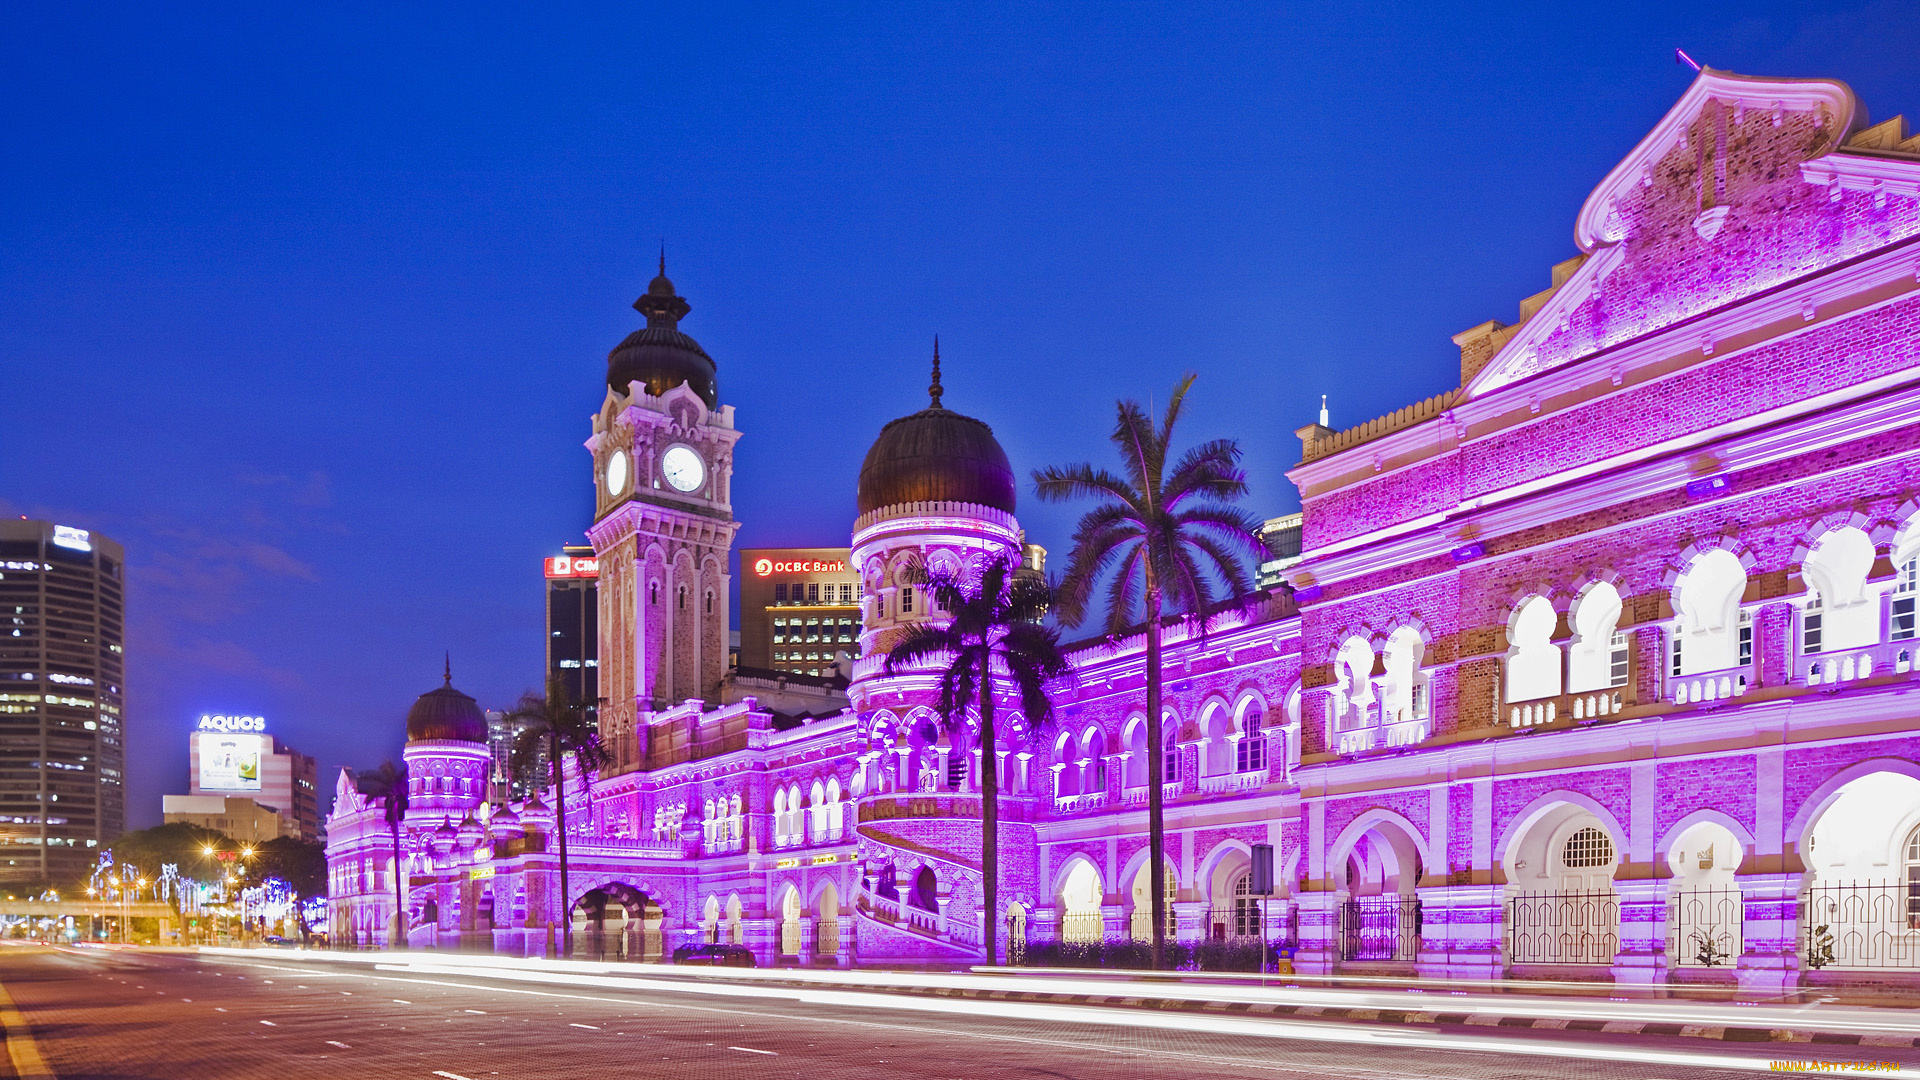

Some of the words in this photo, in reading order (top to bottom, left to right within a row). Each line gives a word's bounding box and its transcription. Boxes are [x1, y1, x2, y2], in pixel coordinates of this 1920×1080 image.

[775, 561, 810, 572] OCBC
[813, 561, 845, 572] Bank
[198, 715, 265, 732] AQUOS
